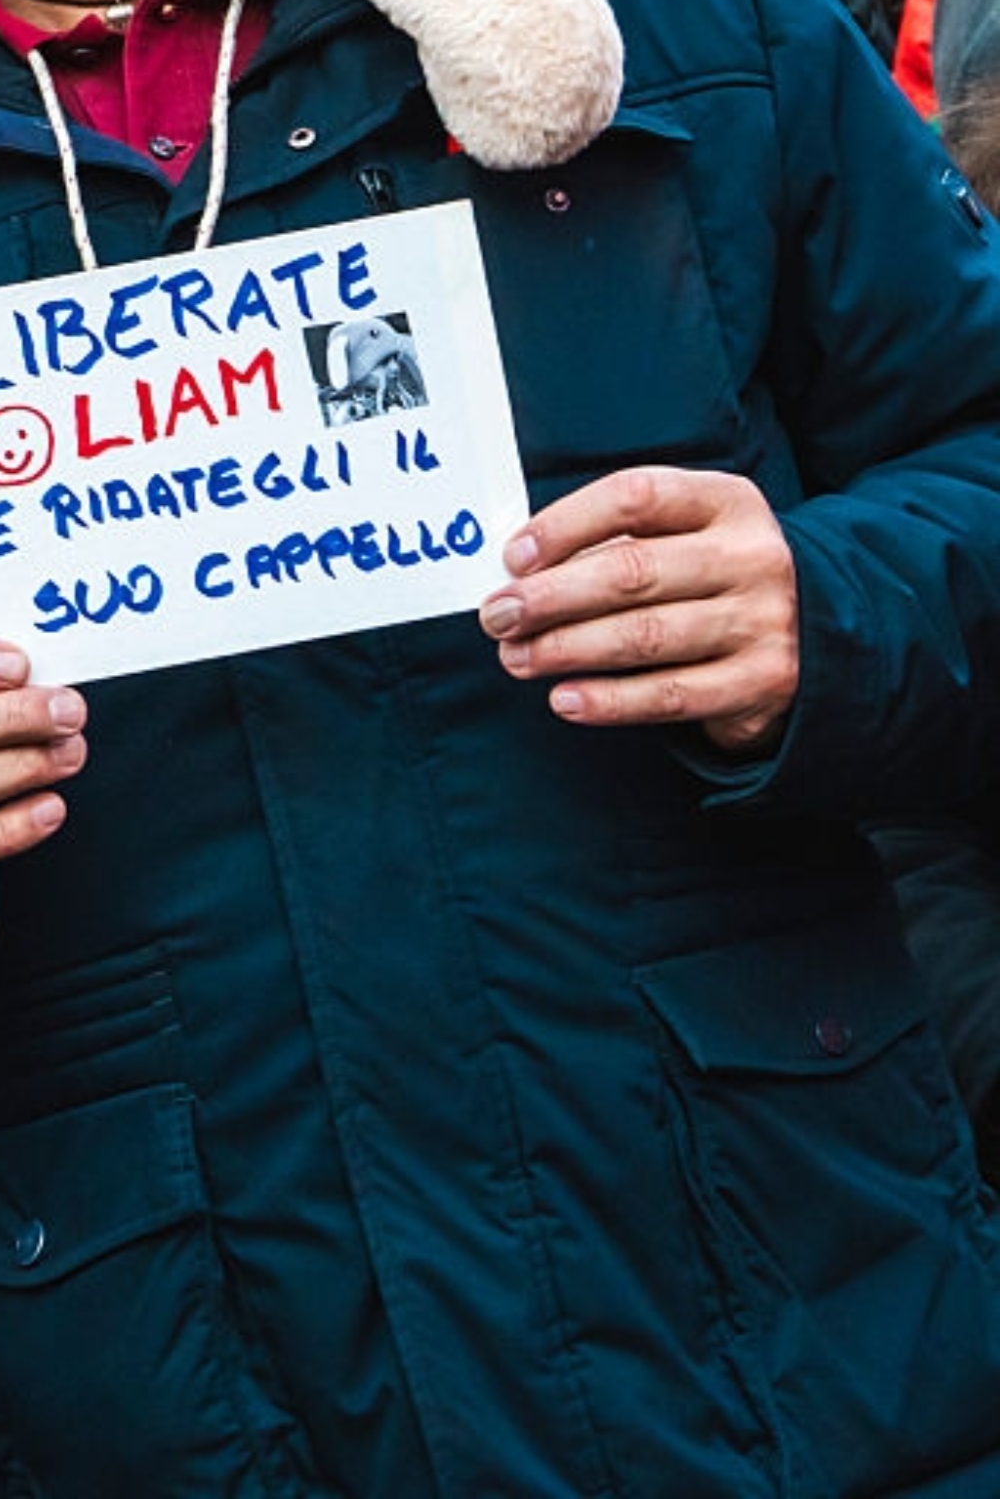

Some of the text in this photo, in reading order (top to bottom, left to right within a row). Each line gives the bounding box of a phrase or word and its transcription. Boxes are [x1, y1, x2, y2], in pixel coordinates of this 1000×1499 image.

[75, 347, 282, 459] LIAM
[42, 440, 352, 540] RIDATEGLI
[396, 429, 441, 473] IL
[32, 508, 485, 634] SUO CAPPELLO
